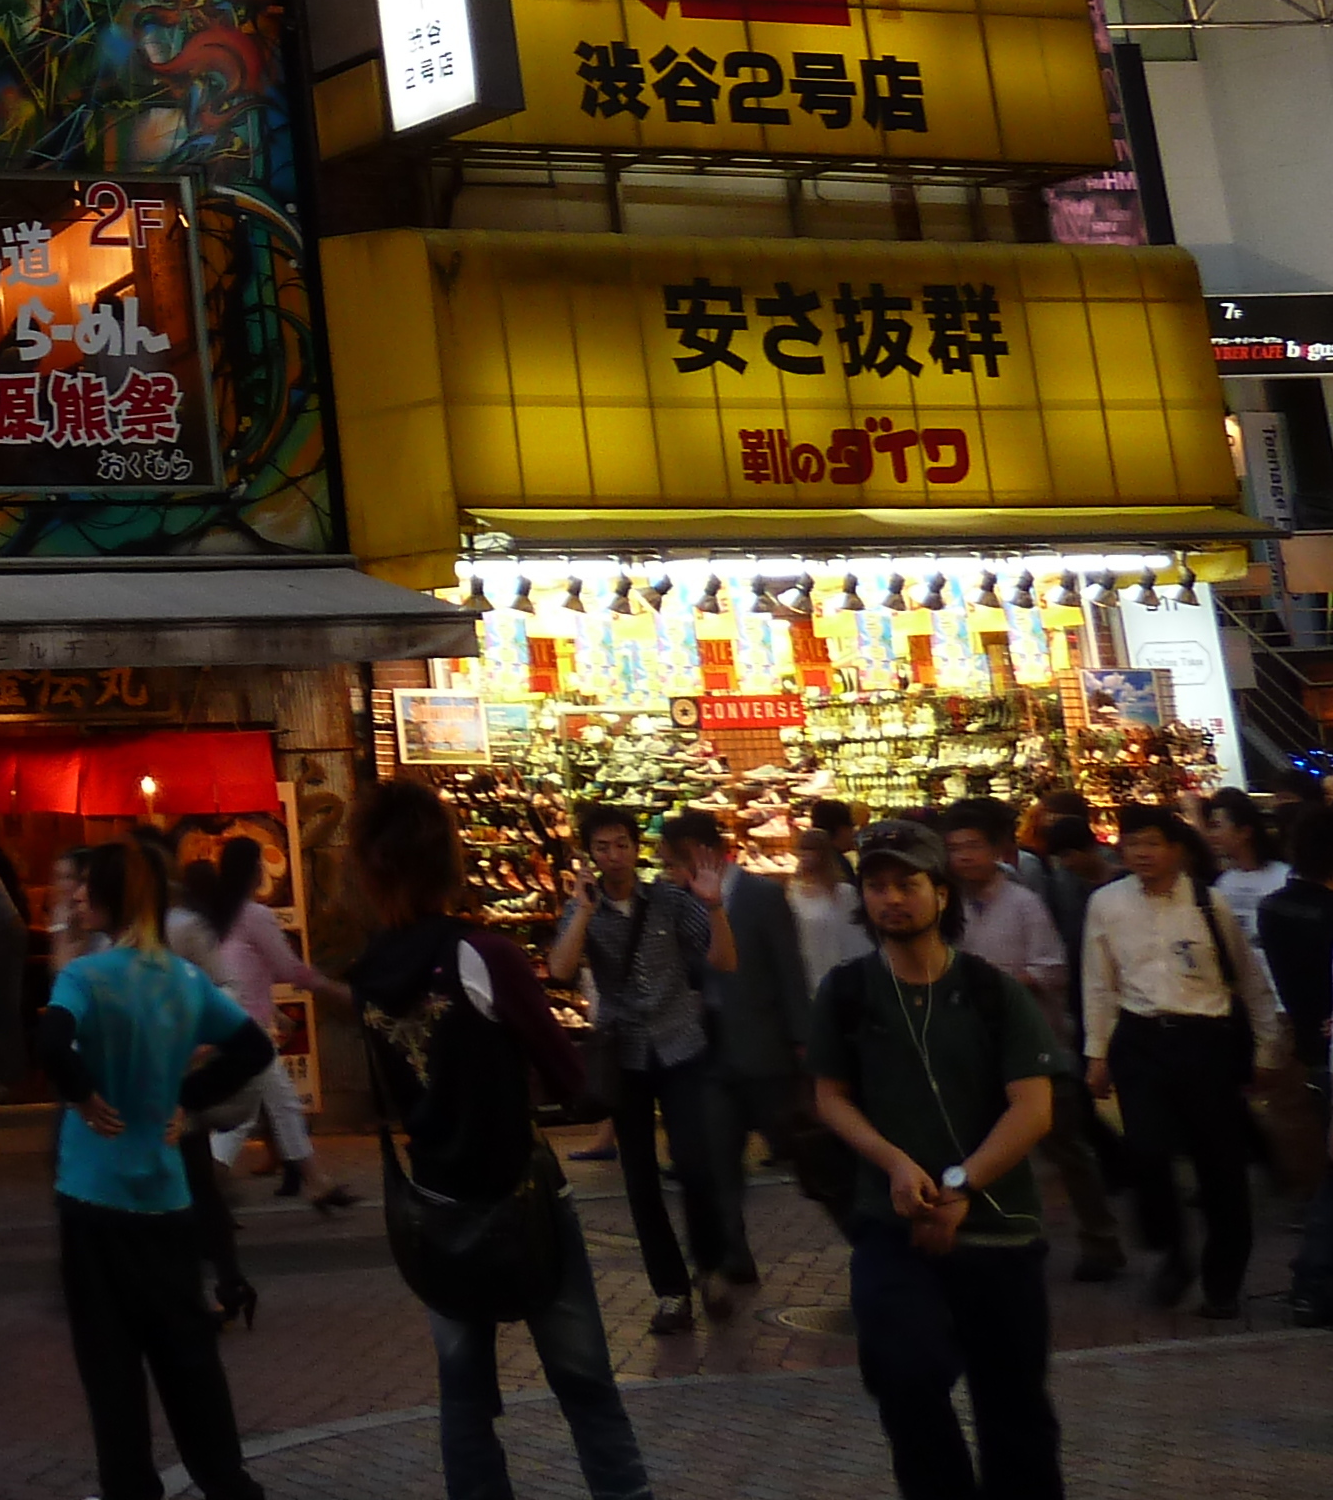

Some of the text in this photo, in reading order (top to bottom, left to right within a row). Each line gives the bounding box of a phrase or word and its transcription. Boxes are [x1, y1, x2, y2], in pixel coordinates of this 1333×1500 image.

[573, 41, 930, 134] 渋谷2号店
[85, 180, 165, 249] 2F
[16, 295, 171, 361] らーめん
[663, 277, 1009, 378] 安さ抜群
[1219, 302, 1244, 320] 7F
[1251, 345, 1285, 360] CAFE
[97, 449, 193, 481] おくむら
[739, 417, 970, 486] 靴のダイワ
[700, 699, 803, 721] CONVERSE
